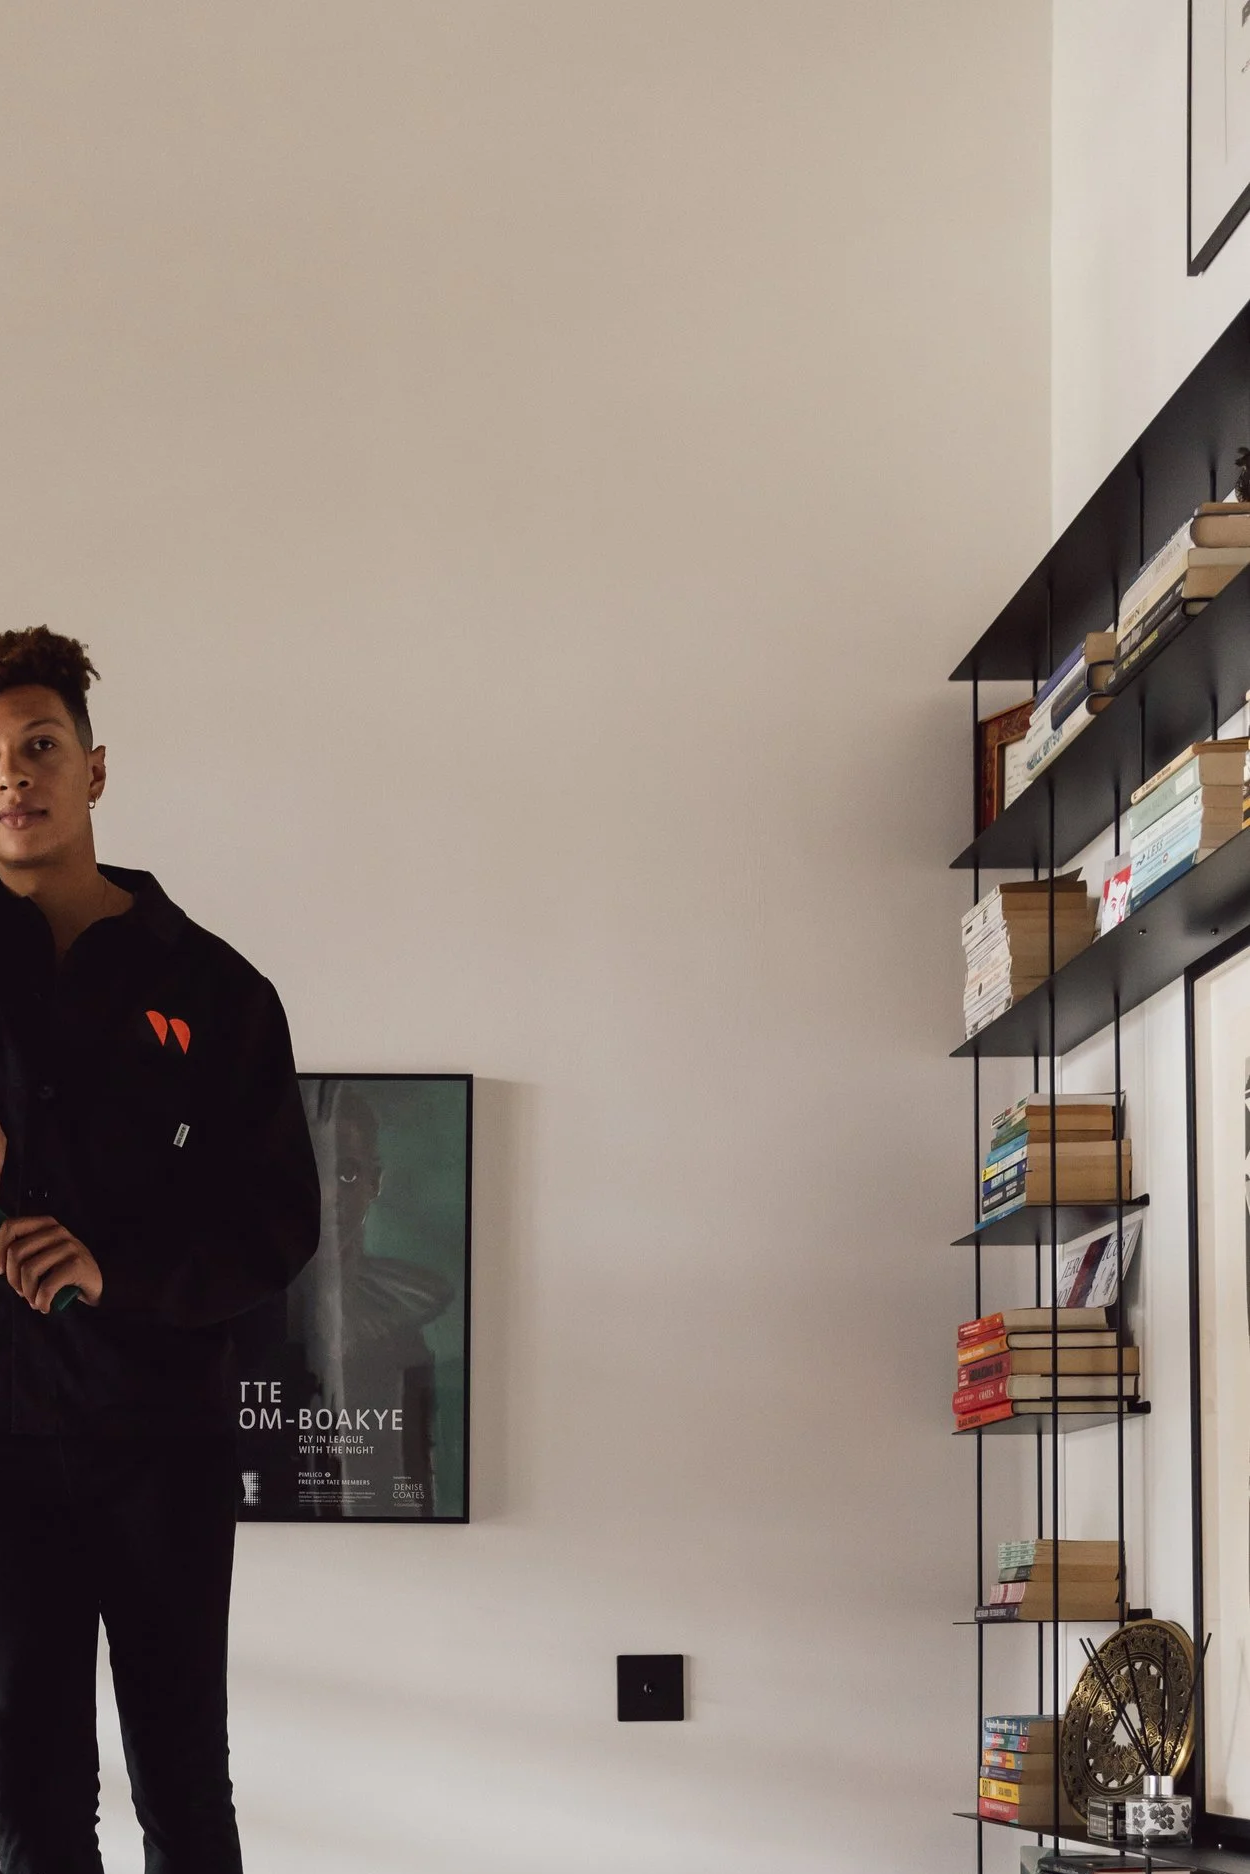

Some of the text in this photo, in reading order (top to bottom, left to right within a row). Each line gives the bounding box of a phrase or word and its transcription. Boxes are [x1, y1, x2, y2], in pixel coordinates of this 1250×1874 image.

[299, 1435, 364, 1444] FLY IN LEAGUE
[299, 1446, 375, 1455] WITH THE NIGHT
[394, 1483, 423, 1491] DENISE
[392, 1491, 425, 1499] COATES
